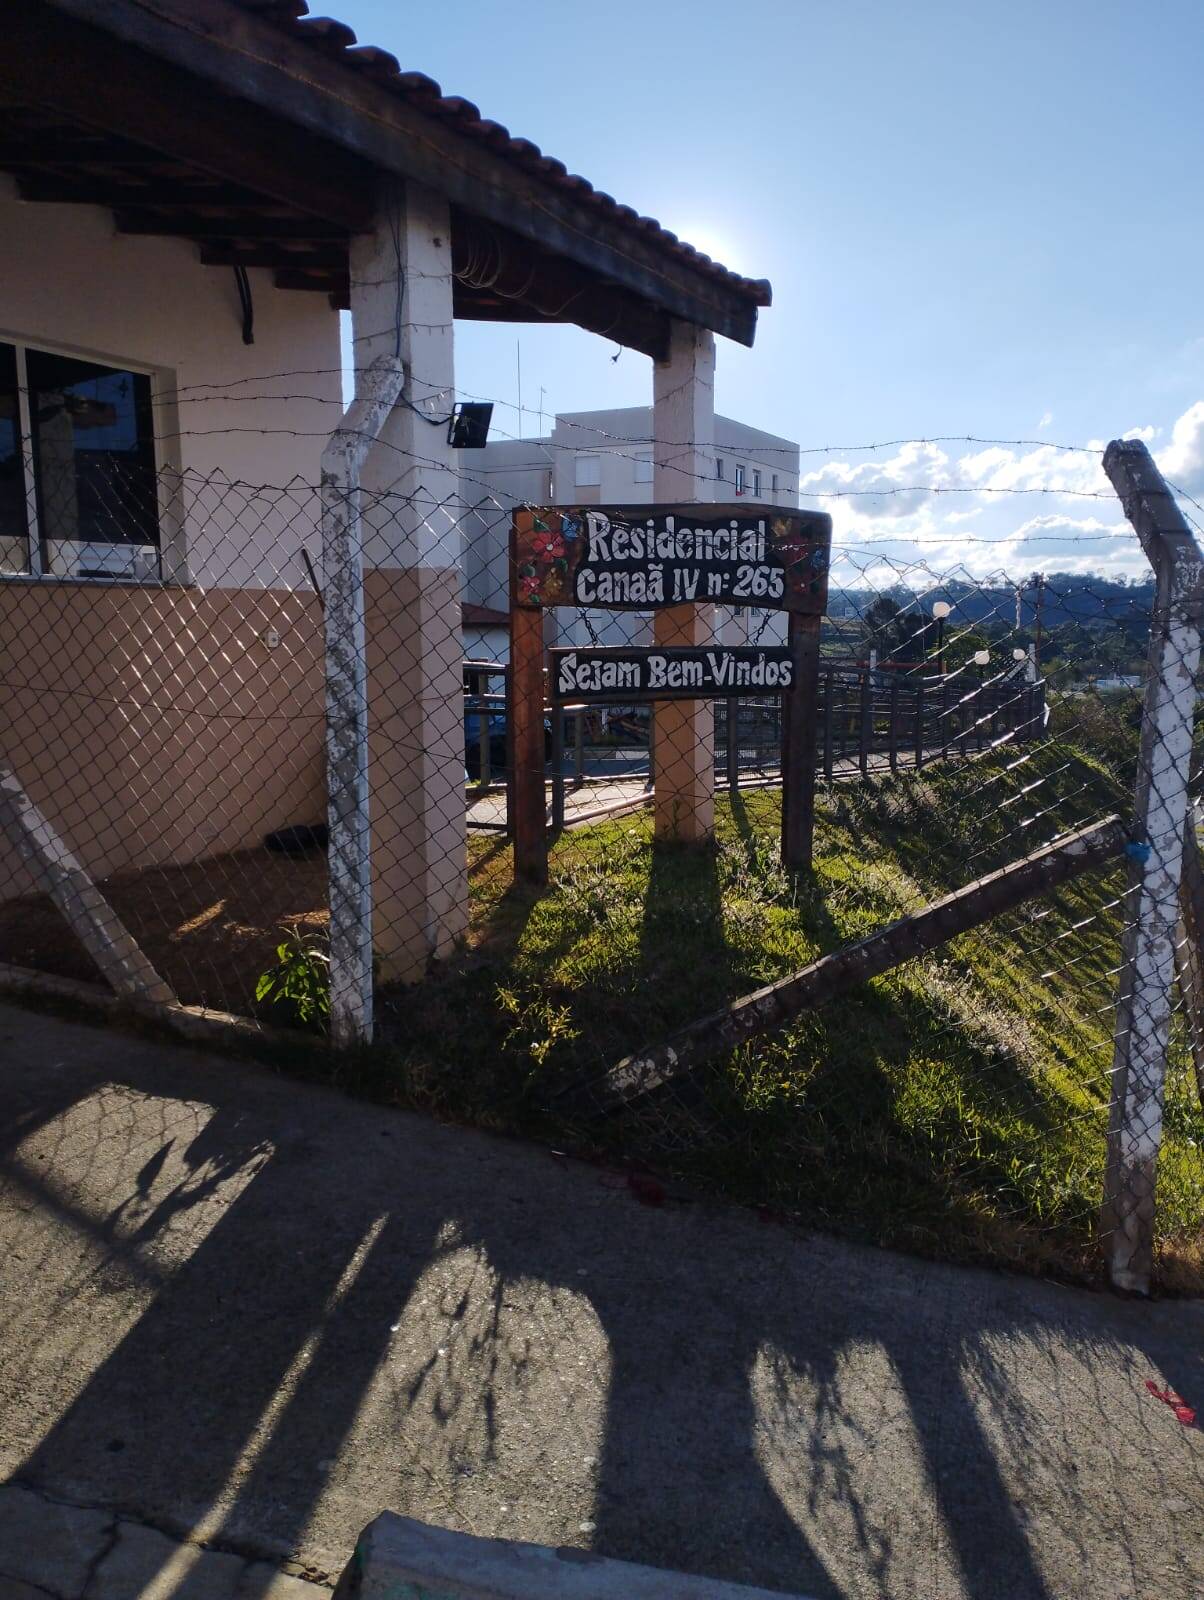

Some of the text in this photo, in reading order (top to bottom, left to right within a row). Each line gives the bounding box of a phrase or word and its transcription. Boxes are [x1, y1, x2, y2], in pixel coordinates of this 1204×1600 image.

[586, 511, 766, 562] Residencial
[576, 563, 665, 603] Canaã
[671, 568, 700, 601] IV
[732, 565, 785, 598] 265
[647, 651, 794, 688] Bem-Vindos
